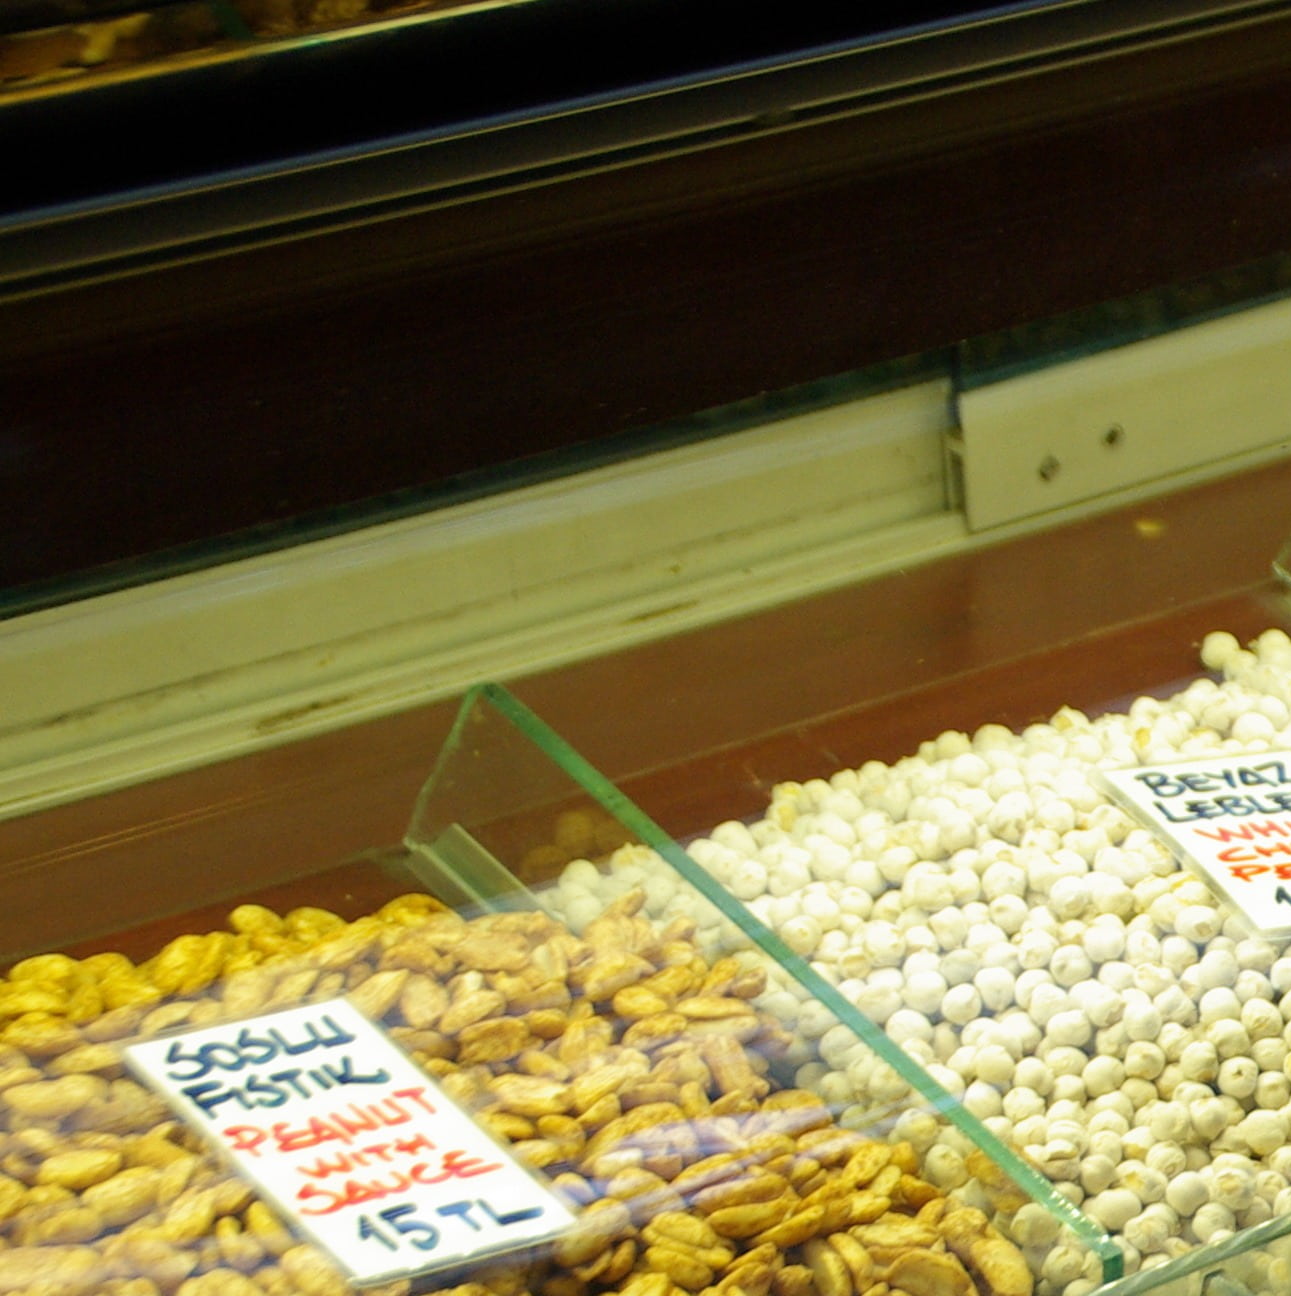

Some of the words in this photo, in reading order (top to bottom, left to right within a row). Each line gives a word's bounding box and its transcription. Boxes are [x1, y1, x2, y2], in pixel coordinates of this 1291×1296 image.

[165, 1014, 356, 1081] SOSLU
[223, 1086, 439, 1157] PEANUT
[295, 1149, 503, 1216] SAUCE
[296, 1132, 437, 1181] WITH
[356, 1201, 442, 1252] 15
[435, 1197, 545, 1232] TL
